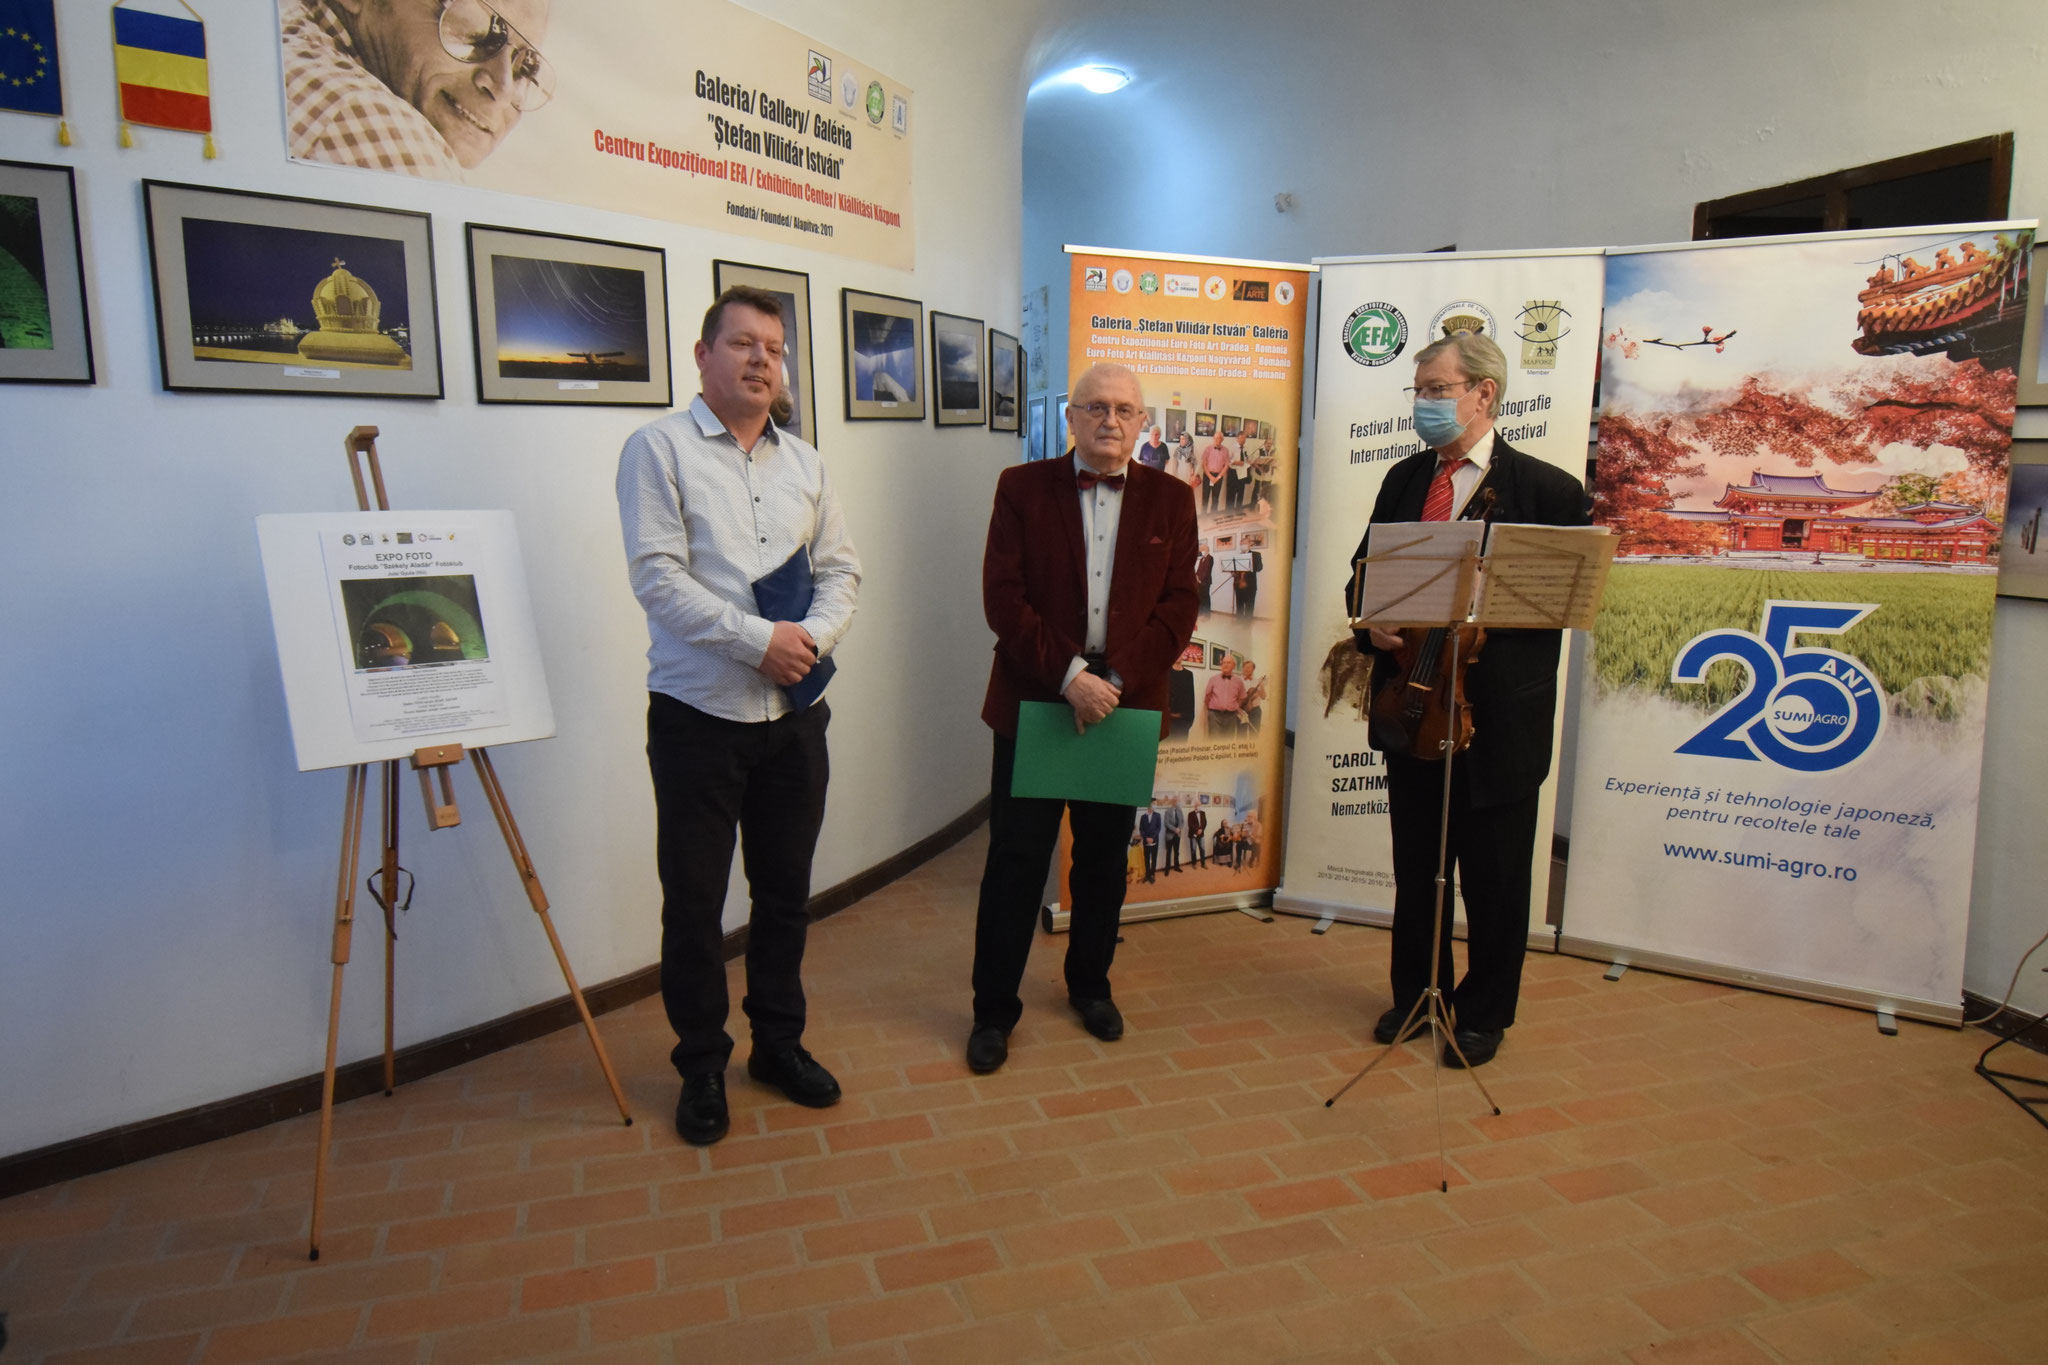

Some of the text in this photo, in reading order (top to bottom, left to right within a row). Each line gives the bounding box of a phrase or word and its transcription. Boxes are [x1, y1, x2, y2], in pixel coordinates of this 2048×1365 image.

[695, 69, 852, 150] Galeria/ Gallery/ Galéria
[764, 130, 804, 168] Vilidár
[594, 129, 645, 162] Centru
[648, 141, 728, 179] Expozițional
[730, 161, 748, 185] EFA
[756, 168, 803, 200] Exhibition
[805, 182, 837, 209] Center/
[838, 193, 874, 220] Kiállítási
[874, 203, 901, 228] Központ
[760, 208, 793, 228] Founded/
[821, 223, 834, 237] 2017
[1091, 315, 1132, 330] Galeria
[1176, 320, 1210, 335] Vilidár
[1252, 325, 1289, 340] Galéria
[1433, 303, 1465, 331] INTERNATIONALE
[1448, 318, 1479, 331] FIAP
[1091, 334, 1120, 345] Centru
[1171, 339, 1188, 349] Euro
[1189, 340, 1206, 350] Foto
[1207, 341, 1219, 351] Art
[1220, 342, 1250, 352] Oradea
[1255, 343, 1288, 355] Romania
[1361, 327, 1391, 346] EFA
[1086, 347, 1106, 358] Euro
[1107, 348, 1124, 359] Foto
[1125, 350, 1138, 359] Art
[1208, 354, 1251, 366] Nagyvárad
[1137, 364, 1148, 373] Art
[1150, 364, 1189, 376] Exhibition
[1190, 366, 1217, 377] Center
[1218, 367, 1247, 378] Oradea
[1253, 369, 1286, 380] Romania
[1350, 417, 1393, 439] Festival
[1499, 394, 1551, 417] otografie
[1350, 420, 1547, 465] International Festival
[348, 563, 379, 571] Fotoclub
[375, 551, 433, 562] EXPO FOTO
[1674, 602, 1882, 773] 25
[1818, 658, 1873, 699] ANI
[1212, 743, 1231, 752] Corpul
[1331, 775, 1389, 793] SZATHM
[1331, 799, 1391, 817] Nemzetköz
[1604, 777, 1937, 831] Experiență și tehnologie japoneză,
[1666, 805, 1861, 841] pentru recoltele tale
[1663, 842, 1858, 882] www.sumi-agro.ro
